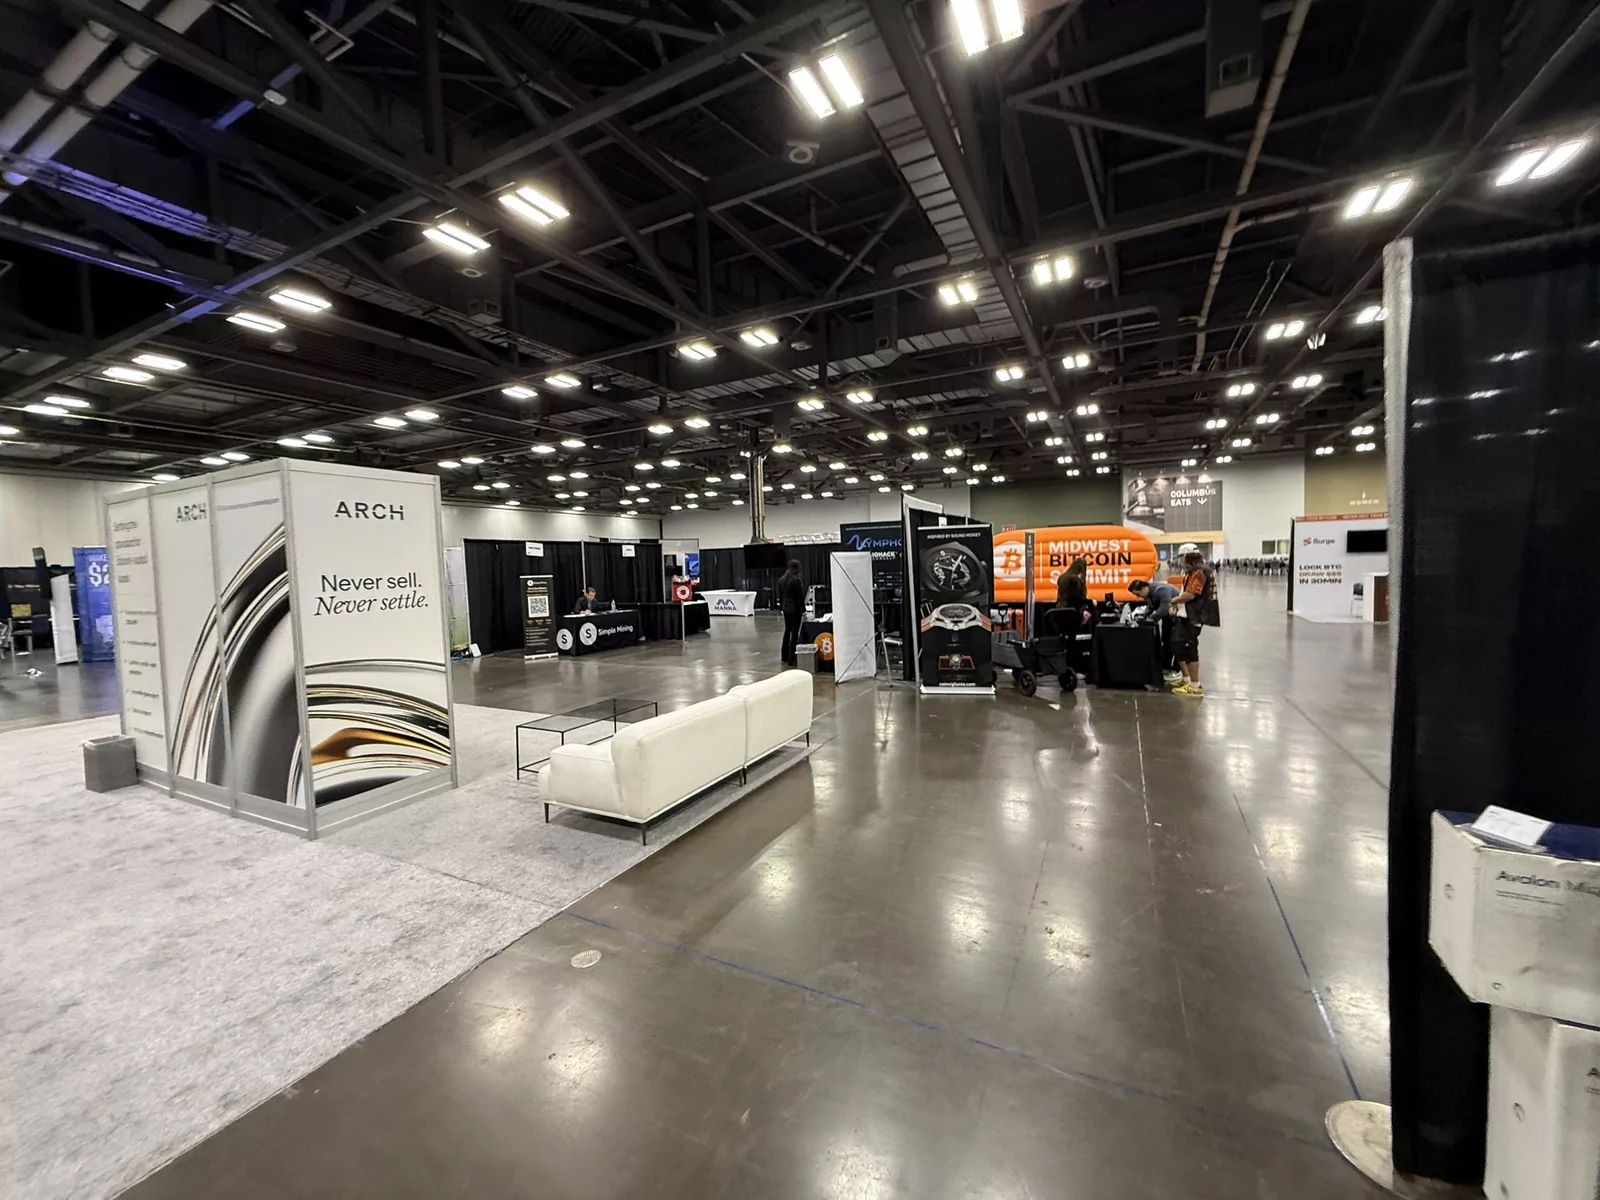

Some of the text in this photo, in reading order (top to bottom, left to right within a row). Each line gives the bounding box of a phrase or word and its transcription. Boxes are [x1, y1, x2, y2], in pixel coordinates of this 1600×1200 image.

[1170, 485, 1216, 498] COLUMBUS
[1171, 498, 1191, 507] EATS
[176, 503, 207, 523] ARCH
[334, 501, 404, 521] ARCH
[1049, 539, 1131, 554] MIDWEST
[1313, 537, 1335, 545] Surge
[1050, 552, 1131, 567] BITCOIN
[321, 572, 422, 592] Never sell.
[1049, 568, 1131, 585] SMIT
[314, 590, 428, 616] Never settle.
[598, 626, 616, 636] Simple
[616, 624, 634, 634] Mining
[1495, 870, 1560, 888] Avalon
